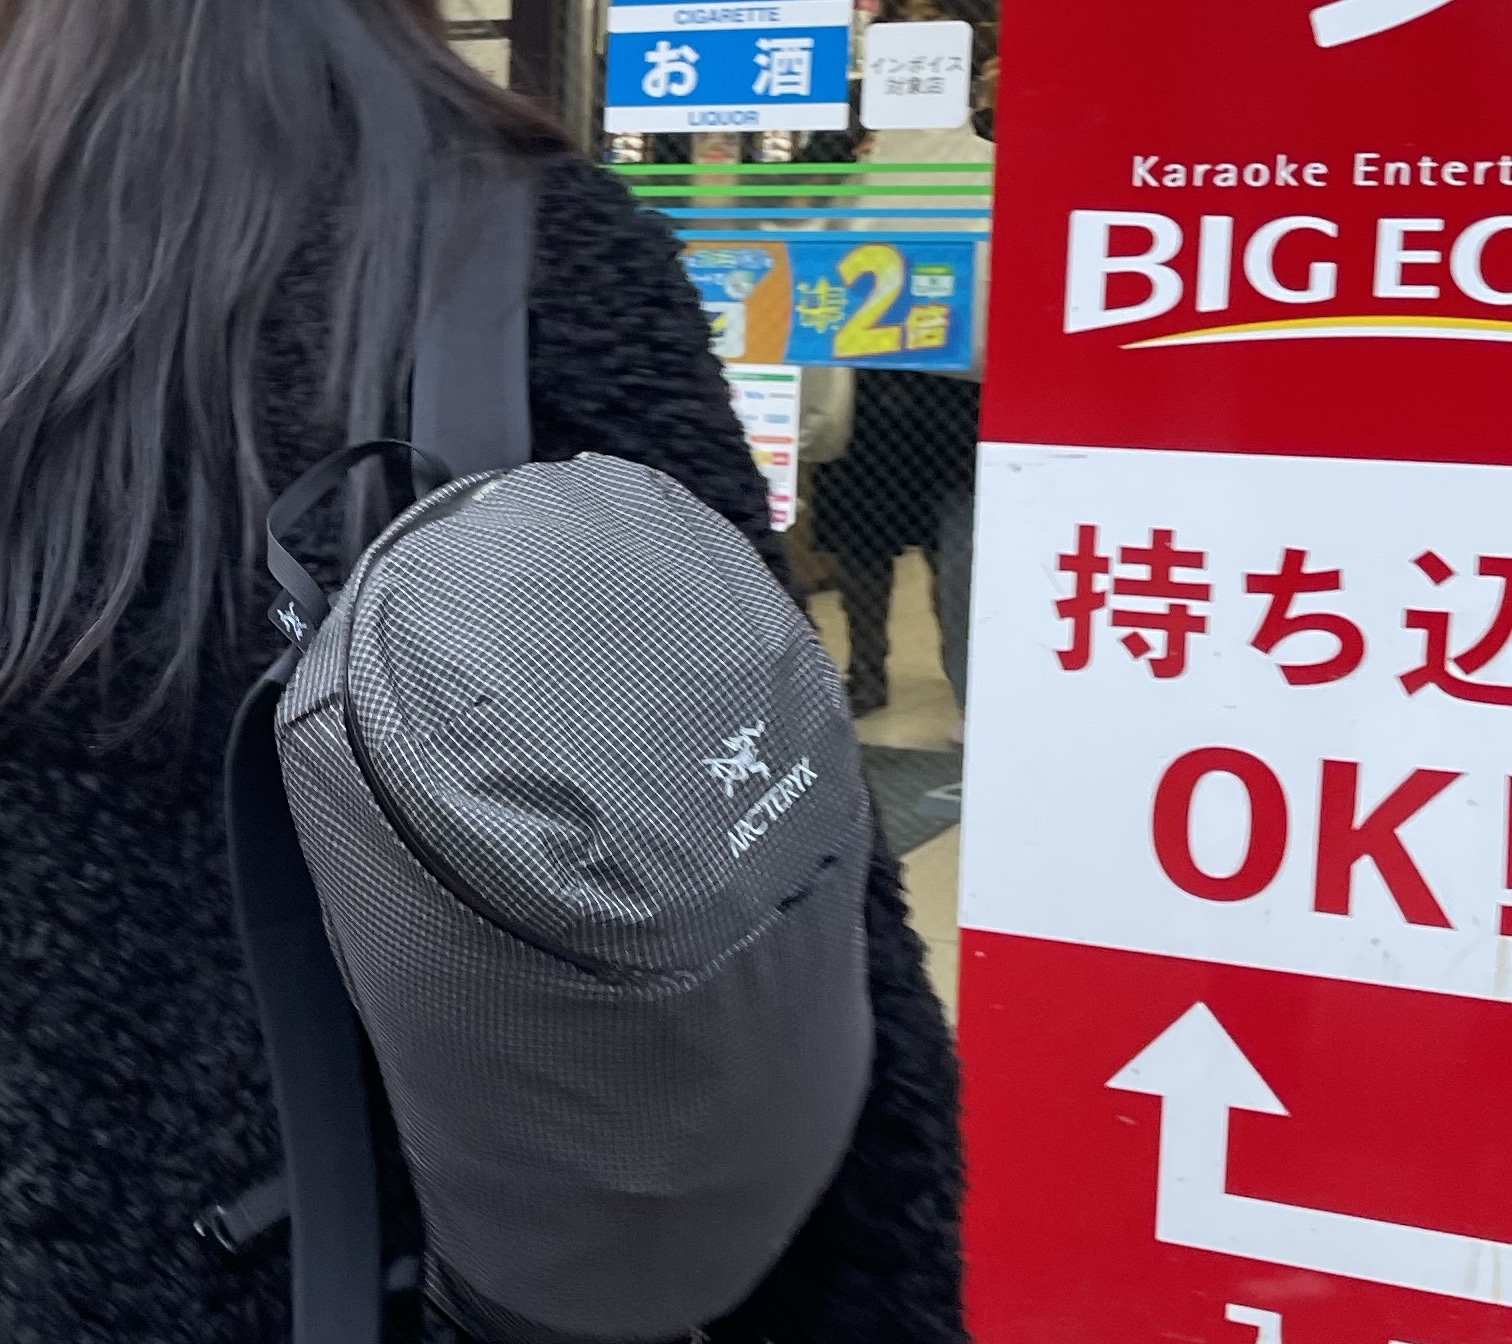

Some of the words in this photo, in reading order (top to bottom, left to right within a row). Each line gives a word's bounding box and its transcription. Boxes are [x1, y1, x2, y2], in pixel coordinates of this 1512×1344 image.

[673, 6, 782, 25] CIGARETTE
[868, 55, 965, 75] インボイス
[686, 110, 760, 127] LIQUOR
[1131, 154, 1329, 188] Karaoke
[1063, 209, 1339, 334] BIG
[1053, 522, 1512, 707] 持ち込
